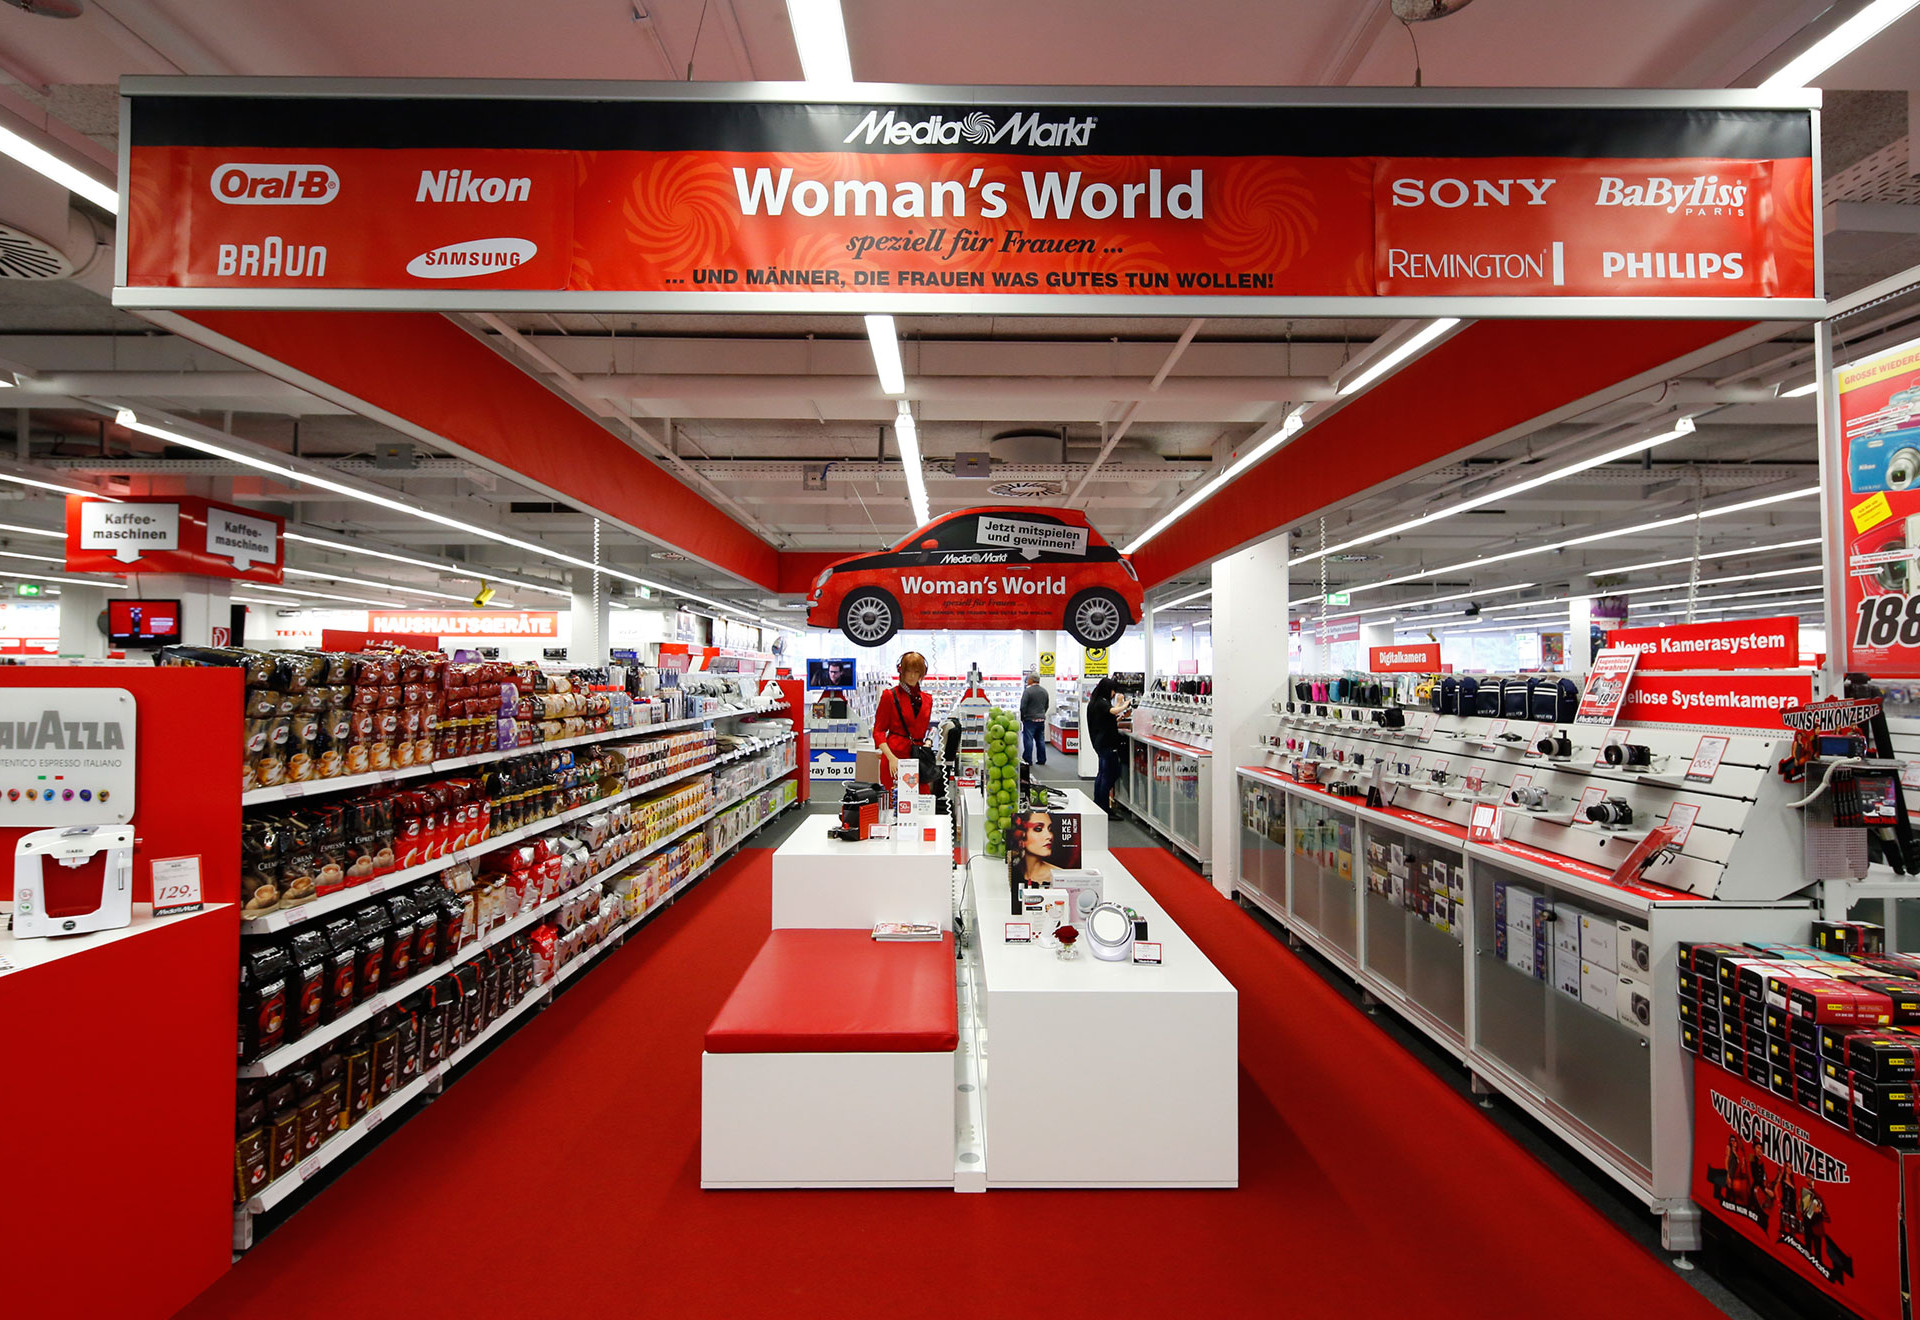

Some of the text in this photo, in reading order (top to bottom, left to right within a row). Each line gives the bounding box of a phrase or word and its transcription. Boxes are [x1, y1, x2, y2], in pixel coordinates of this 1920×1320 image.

[415, 169, 532, 203] Nikon
[1021, 169, 1203, 221] World
[1392, 178, 1556, 207] SONY
[1595, 176, 1746, 214] BaByliss
[1686, 207, 1745, 217] PARIS
[845, 228, 942, 259] speziell
[943, 229, 996, 260] für
[997, 231, 1096, 255] Frauen
[217, 236, 327, 277] BRAUN
[424, 251, 521, 267] SAMSUNG
[1388, 248, 1543, 279] REMINGTON
[1603, 252, 1744, 279] PHILIPS
[693, 268, 740, 286] UND
[745, 265, 846, 289] MÄNNER,
[854, 270, 890, 287] DIE
[897, 271, 984, 288] FRAUEN
[992, 271, 1039, 288] WAS
[1045, 271, 1119, 289] GUTES
[1125, 272, 1171, 289] TUN
[1177, 272, 1274, 289] WOLLEN!
[1844, 367, 1877, 384] GROSSE
[105, 513, 157, 525] Kaffee-
[93, 528, 167, 540] maschinen
[224, 521, 262, 538] Kaffee-
[985, 521, 1081, 540] Jetzt mitspielen
[215, 535, 269, 554] maschinen
[987, 532, 1076, 550] und gewinnen!
[1002, 576, 1067, 595] World
[373, 613, 552, 634] HAUSHALTSGERÄTE
[1856, 596, 1920, 646] 188
[1661, 633, 1785, 656] Kamerasystem
[1379, 652, 1427, 666] Digitalkamera
[1672, 689, 1799, 710] Systemkamera
[39, 759, 82, 767] ESPRESSO
[83, 759, 122, 768] ITALIANO
[827, 767, 840, 775] Top
[1062, 818, 1072, 826] MA
[1062, 833, 1072, 841] UP
[158, 884, 198, 900] 129.-
[1741, 1097, 1810, 1141] DAS LEBEN IST EIN
[1710, 1089, 1850, 1183] WUNSCHKONZERT.
[1736, 1204, 1748, 1215] NUR
